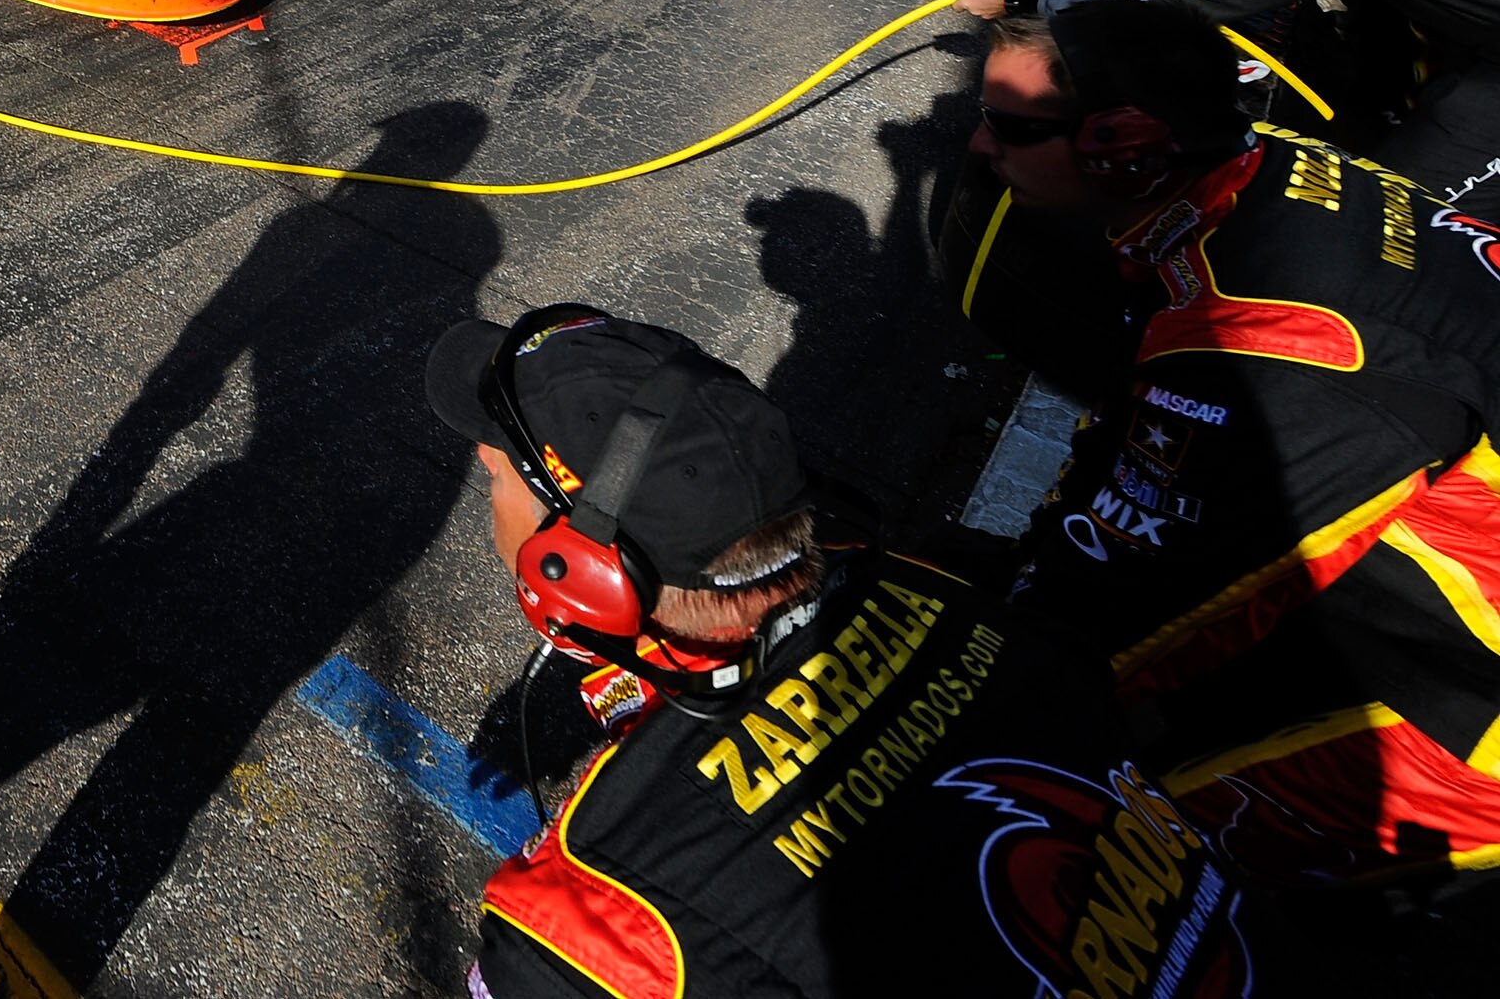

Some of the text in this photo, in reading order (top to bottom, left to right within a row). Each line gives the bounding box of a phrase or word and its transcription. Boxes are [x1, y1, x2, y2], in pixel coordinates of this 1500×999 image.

[1144, 384, 1228, 426] NASCAR
[1091, 485, 1169, 547] WIX
[1176, 497, 1187, 515] 1
[696, 579, 945, 816] ZARRELLA
